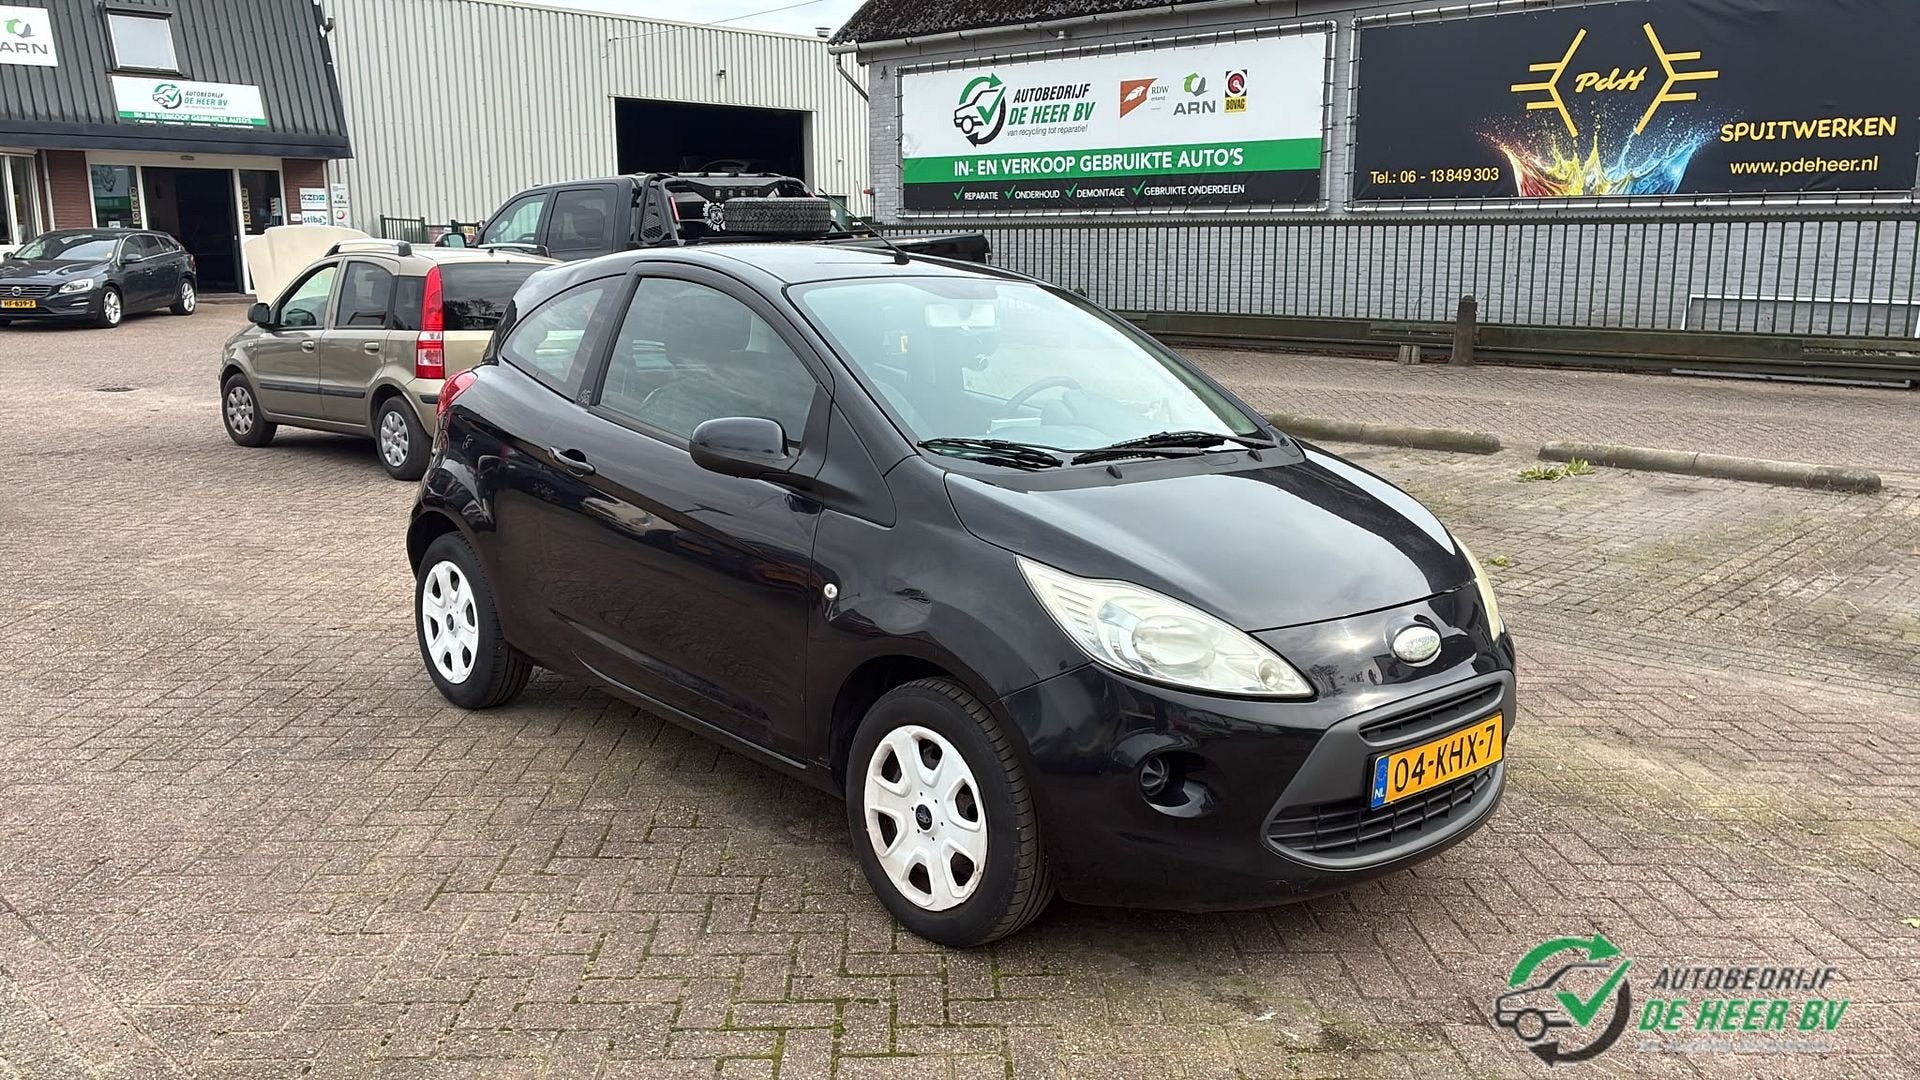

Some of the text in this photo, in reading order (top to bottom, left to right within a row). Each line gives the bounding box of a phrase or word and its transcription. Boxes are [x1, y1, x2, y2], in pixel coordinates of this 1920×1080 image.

[0, 42, 48, 54] ARN
[185, 90, 224, 98] AUTOBEDRIJF
[1013, 83, 1091, 104] AUTOBEDRIJF
[1151, 85, 1169, 95] RDW
[1173, 100, 1216, 116] ARN
[1225, 99, 1245, 110] BOVAG
[1008, 101, 1096, 125] DE HEER BV
[1019, 127, 1047, 137] recycling
[1048, 126, 1057, 134] tot
[1057, 124, 1088, 134] reparatie!
[1720, 116, 1897, 143] SPUITWERKEN
[954, 148, 1244, 177] IN- EN VERKOOP GEBRUIKTE AUTO'S
[1730, 155, 1879, 176] www.pdeheer.nl
[1370, 170, 1396, 184] Tel.:
[1400, 170, 1417, 183] 06
[964, 184, 1245, 200] REPARATIE ONDERHOUD DEMONTAGE GEBRUIKTE ONDERDELEN
[1394, 723, 1496, 793] 04-KHX-7
[1373, 787, 1385, 799] NL
